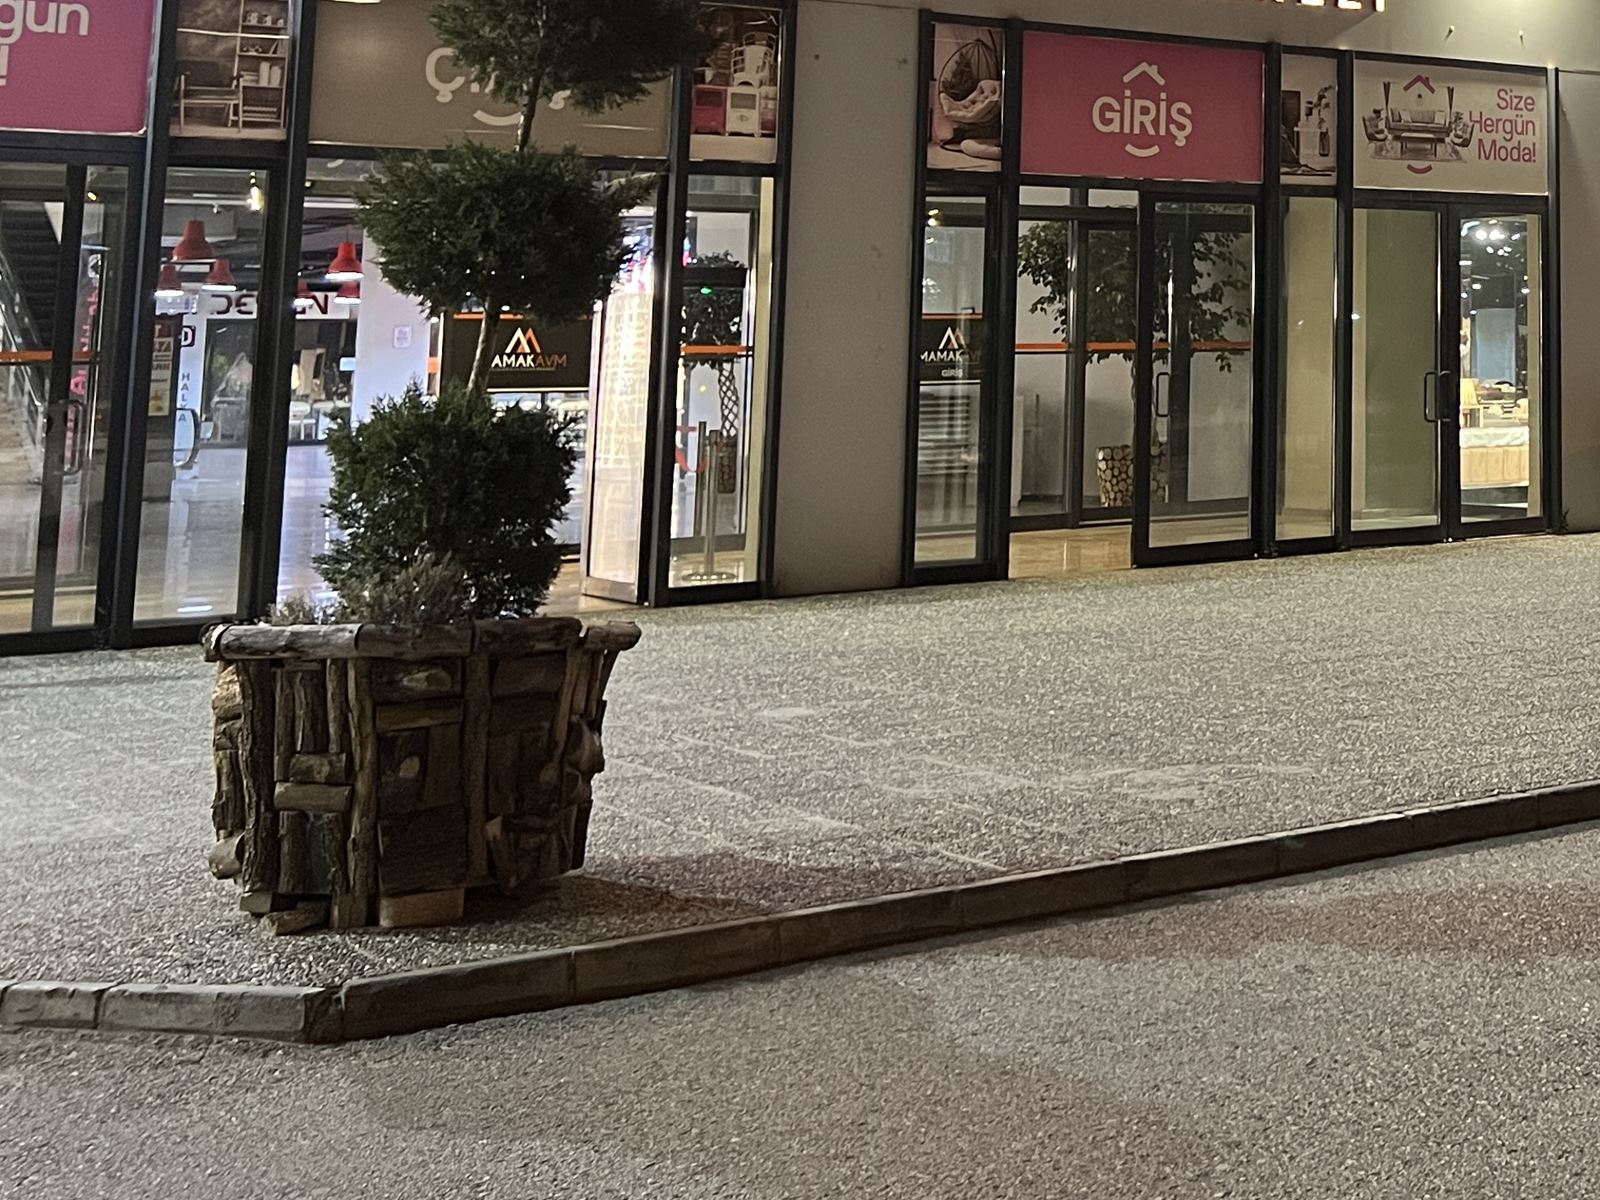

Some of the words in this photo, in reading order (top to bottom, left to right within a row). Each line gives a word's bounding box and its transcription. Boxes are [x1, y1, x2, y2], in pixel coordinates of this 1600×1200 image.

[1496, 87, 1536, 113] Size
[1091, 88, 1194, 149] GİRİŞ
[1468, 109, 1537, 143] Hergün
[1477, 138, 1537, 164] Moda!
